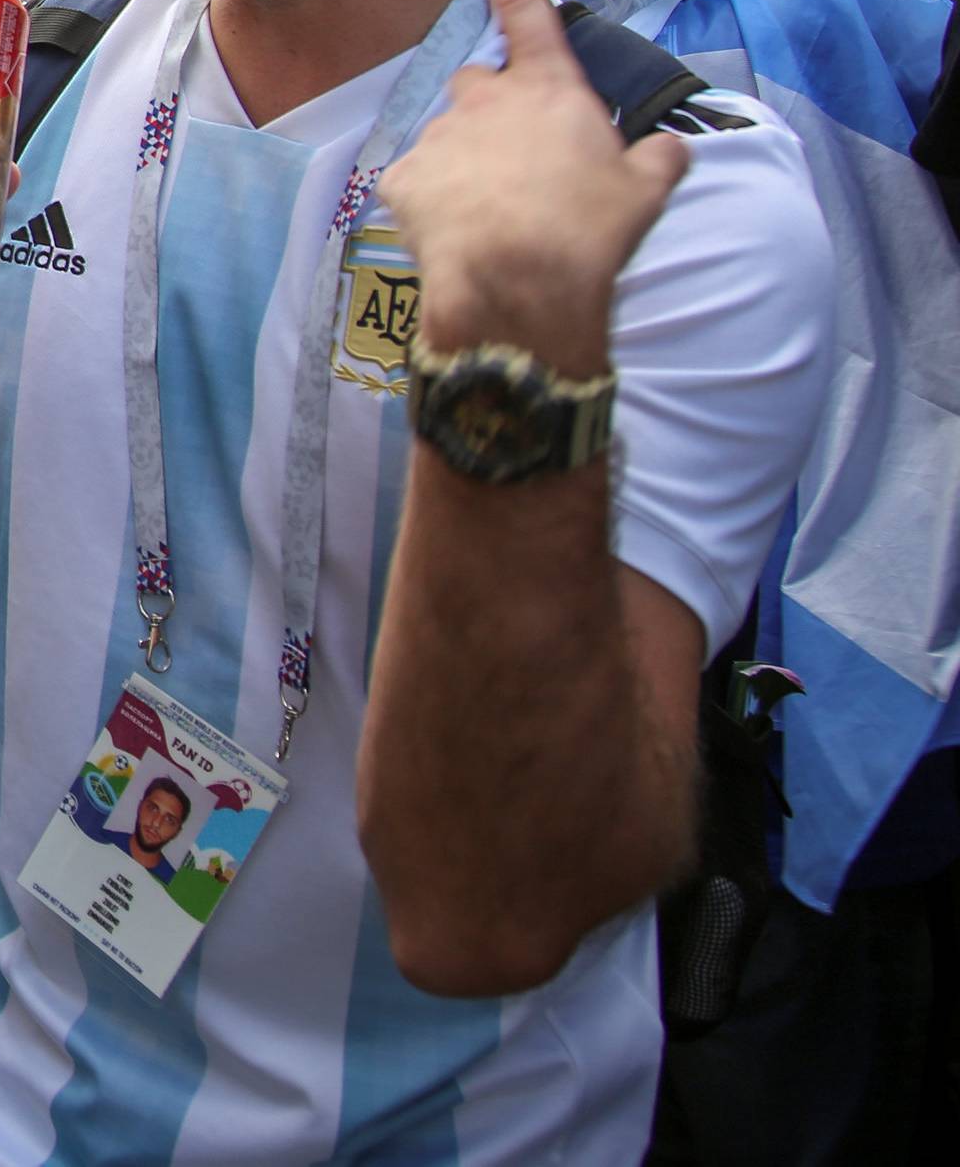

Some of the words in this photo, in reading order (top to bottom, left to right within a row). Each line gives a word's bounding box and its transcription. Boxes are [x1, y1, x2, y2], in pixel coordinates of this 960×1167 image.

[0, 242, 86, 276] adidas
[171, 736, 198, 763] FAN
[196, 755, 215, 773] ID
